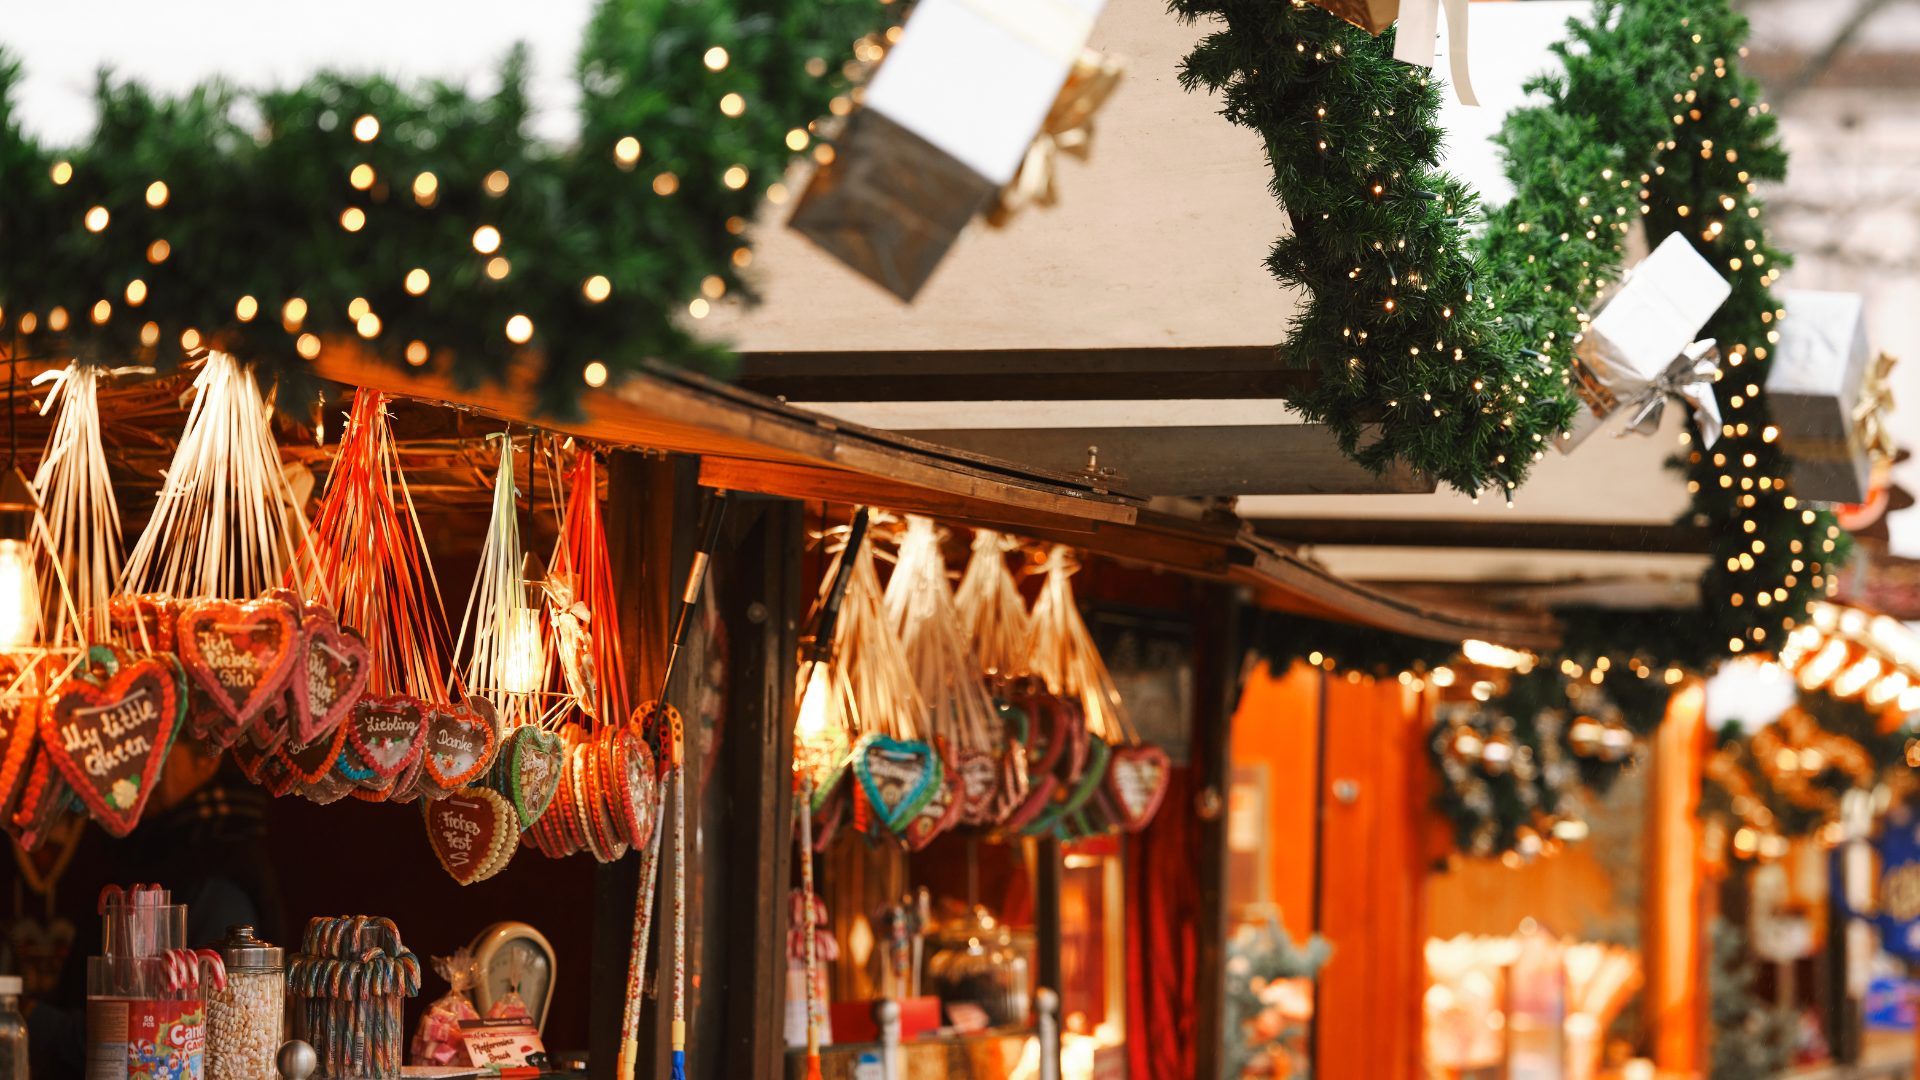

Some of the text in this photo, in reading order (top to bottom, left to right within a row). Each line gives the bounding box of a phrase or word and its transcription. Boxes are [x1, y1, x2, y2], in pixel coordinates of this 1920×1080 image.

[365, 714, 419, 736] Liebling
[436, 728, 473, 752] Danke
[442, 830, 473, 851] Fest
